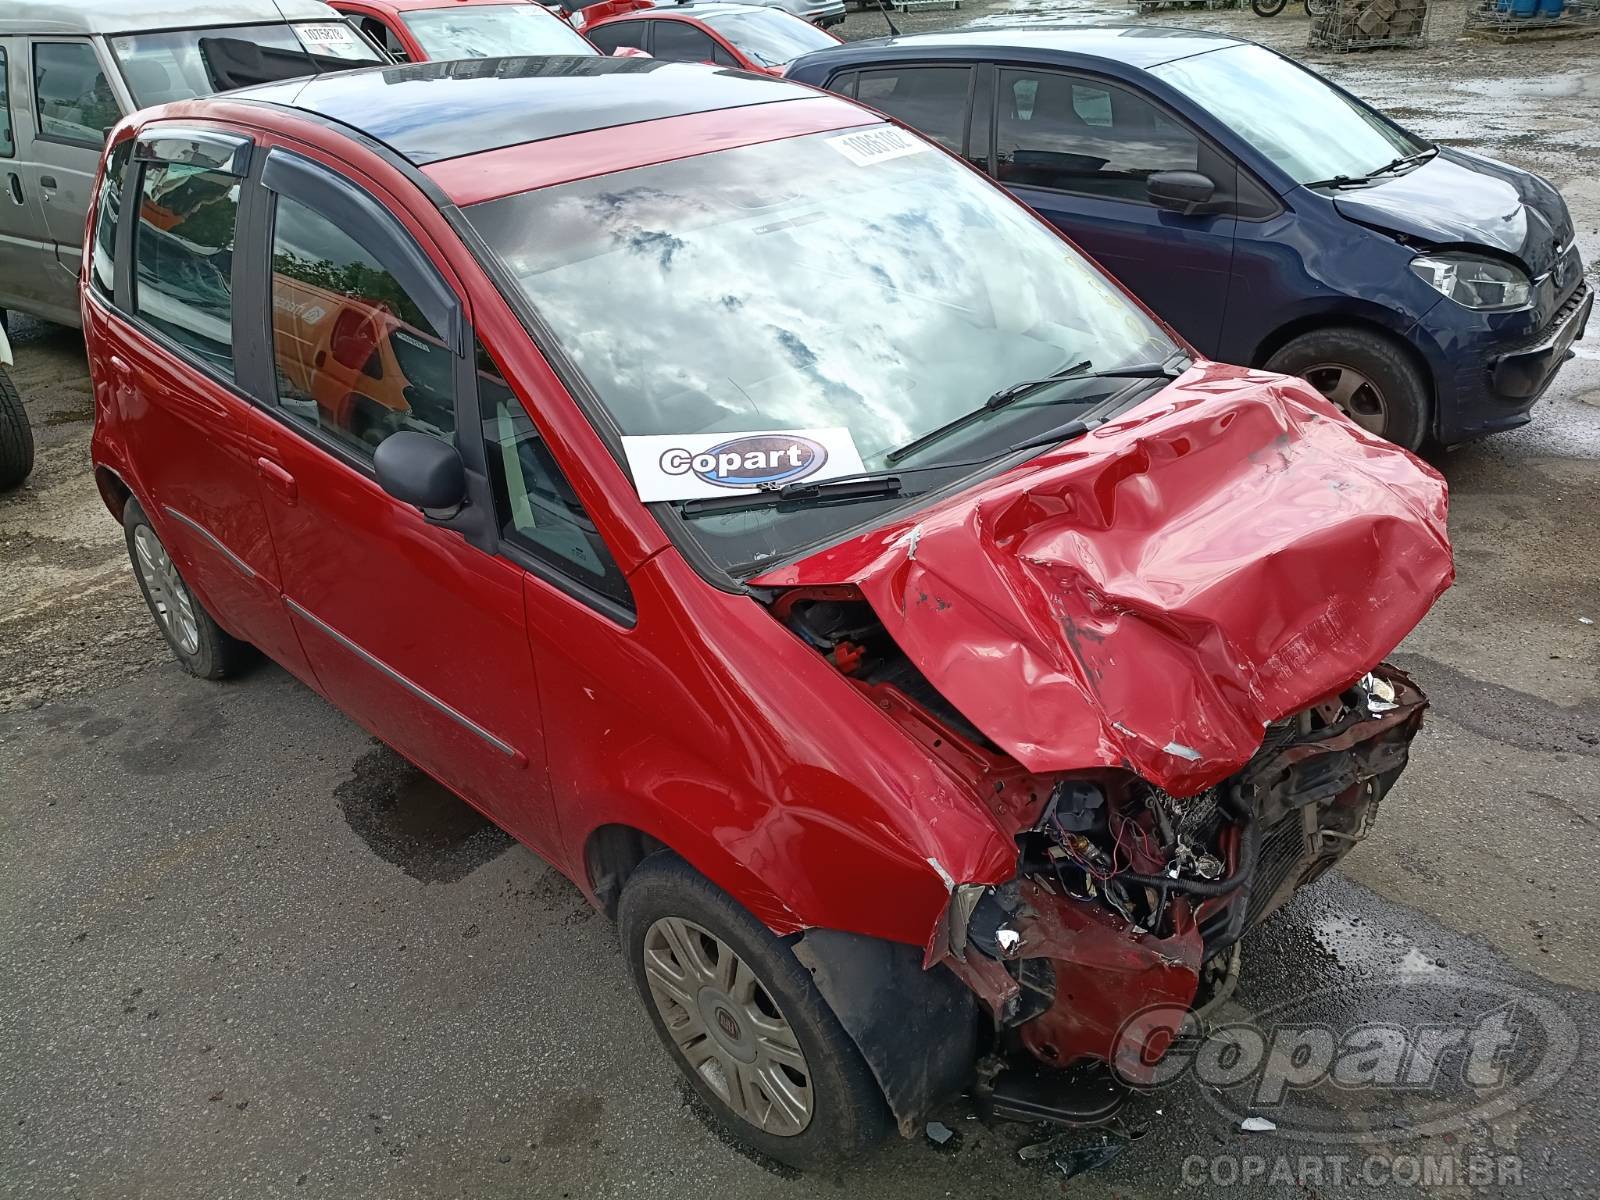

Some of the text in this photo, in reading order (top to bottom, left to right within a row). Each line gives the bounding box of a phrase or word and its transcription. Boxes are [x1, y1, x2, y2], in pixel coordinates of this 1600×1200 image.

[303, 28, 344, 40] 1075878
[841, 130, 912, 157] 1086102
[660, 443, 802, 479] Copart
